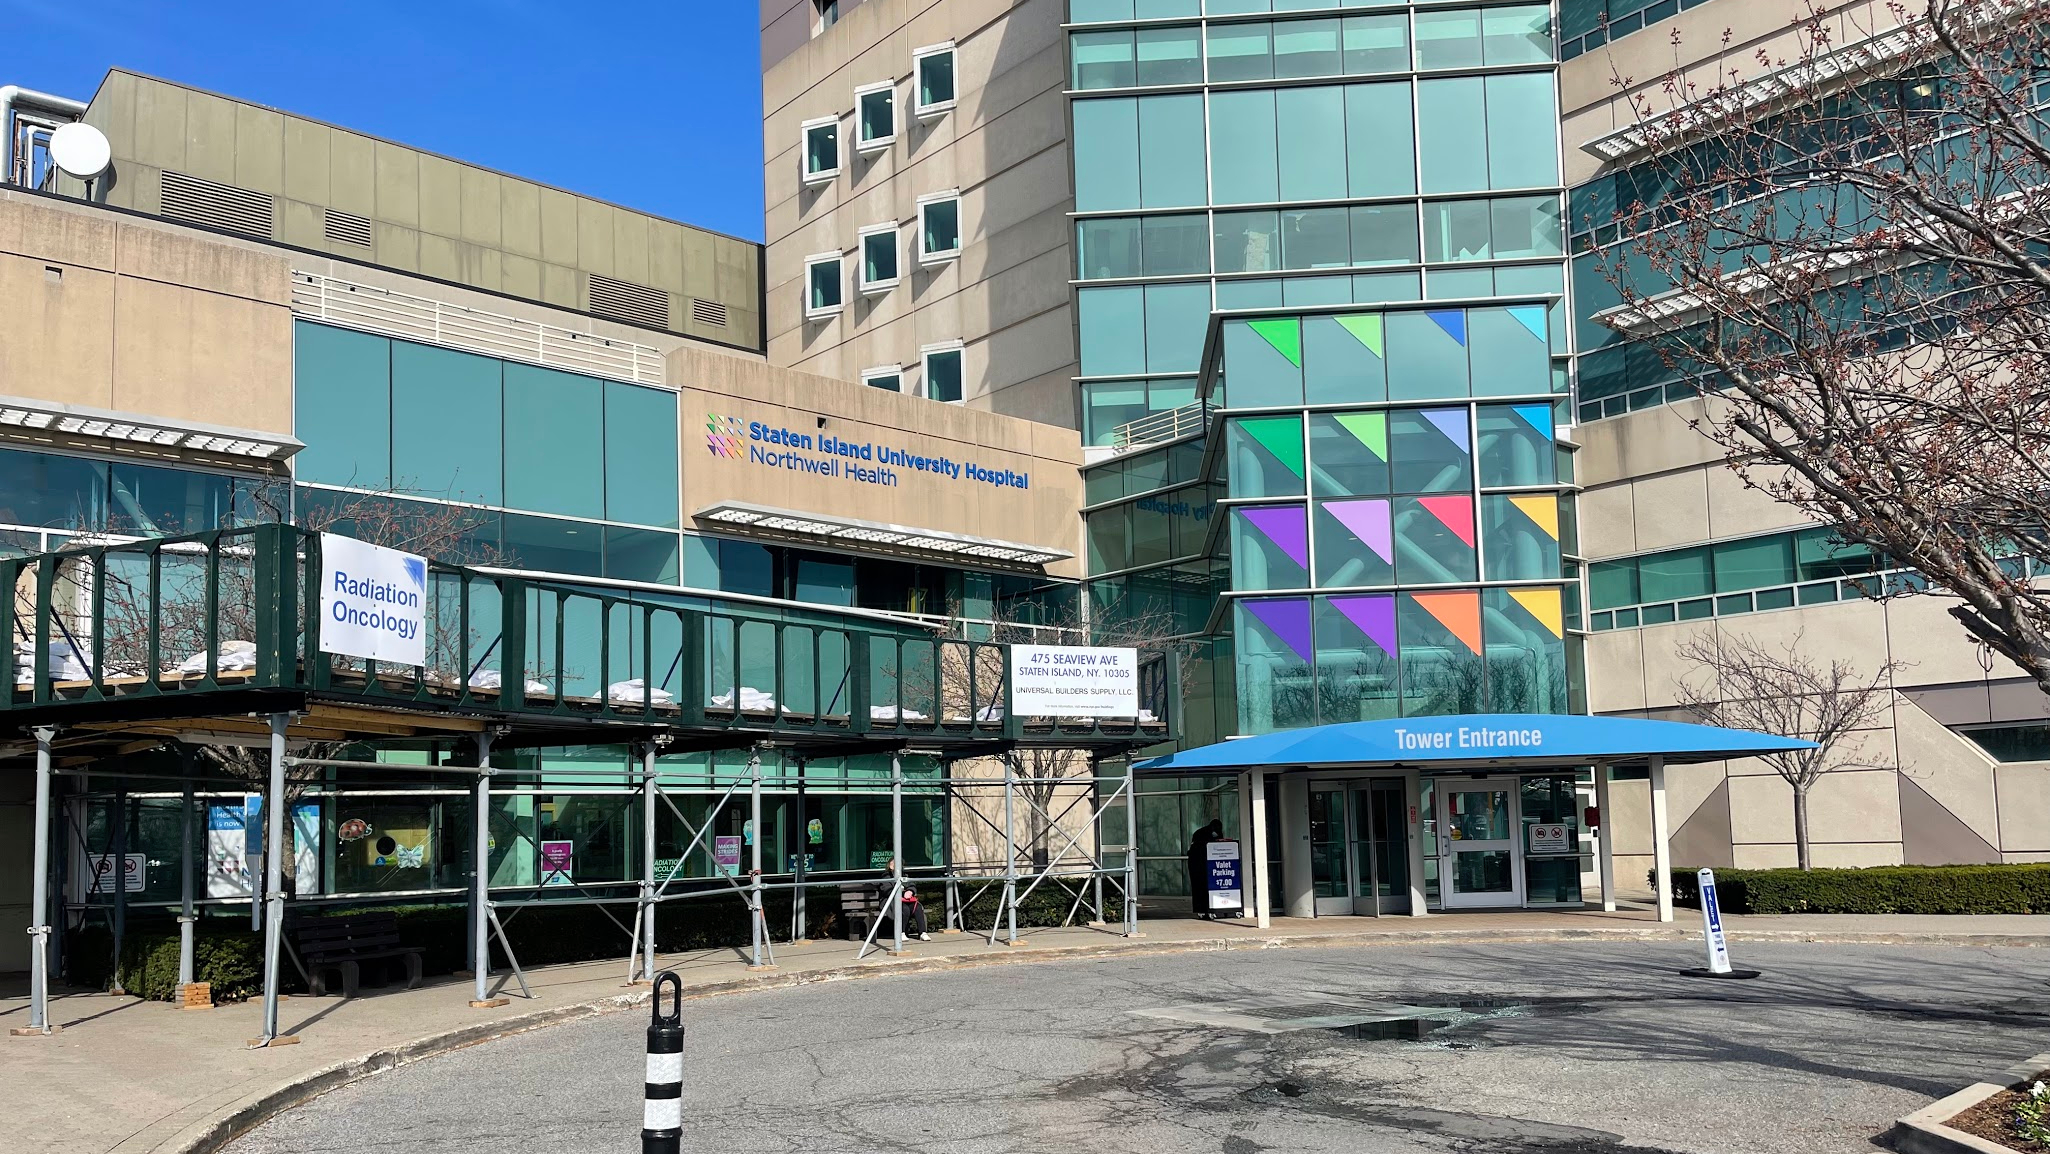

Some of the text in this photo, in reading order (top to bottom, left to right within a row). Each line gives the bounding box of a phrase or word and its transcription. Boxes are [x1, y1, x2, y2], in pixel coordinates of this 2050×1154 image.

[749, 421, 1029, 490] Staten Island University Hospital
[749, 444, 898, 487] Northwell Health
[334, 571, 418, 608] Radiation
[332, 600, 418, 640] Oncology
[1030, 653, 1118, 666] 475 SEAVIEW AVE
[1019, 667, 1130, 678] STATEN ISLAND, NY. 10305
[1055, 687, 1089, 695] BUILDERS
[1395, 727, 1542, 750] Tower Entrance
[1212, 869, 1235, 877] Parking
[1215, 861, 1232, 869] Valet
[1706, 887, 1715, 922] VALET
